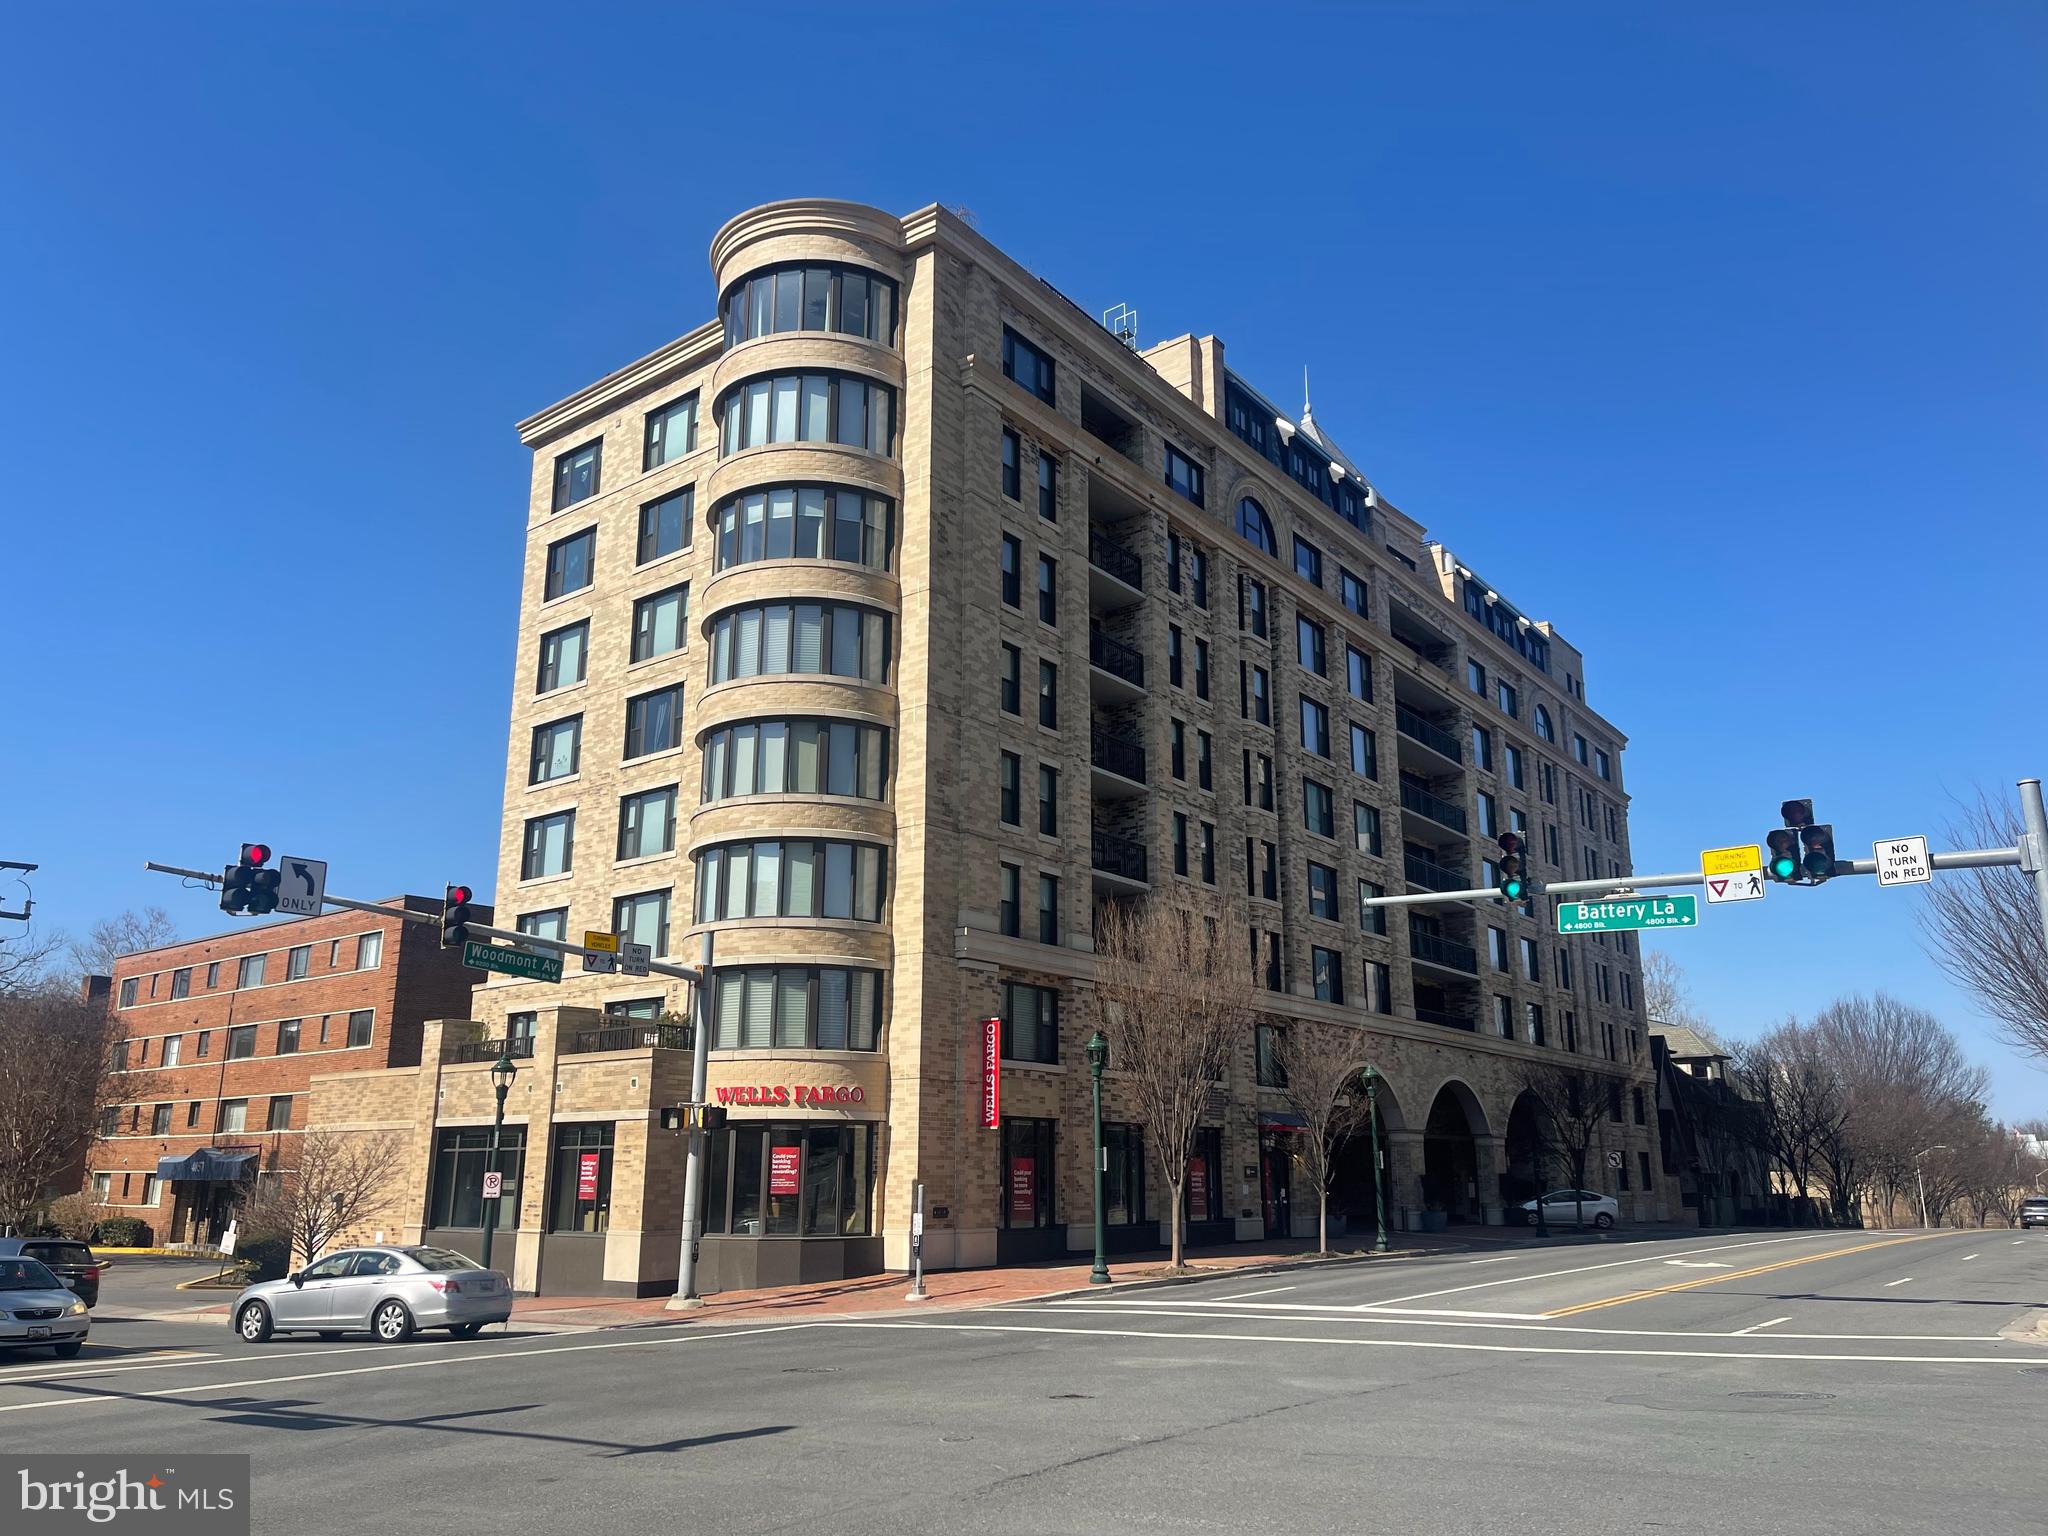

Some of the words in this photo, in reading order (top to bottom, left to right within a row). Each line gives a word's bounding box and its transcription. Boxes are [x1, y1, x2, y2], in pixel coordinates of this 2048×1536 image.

[1891, 844, 1909, 854] NO
[1715, 851, 1747, 861] TURNING
[1887, 855, 1917, 867] TURN
[1714, 860, 1749, 870] VEHICLES
[1883, 870, 1898, 880] ON
[1903, 867, 1925, 878] RED
[281, 897, 316, 911] ONLY
[1577, 903, 1646, 920] Battery
[1653, 900, 1675, 915] La
[1645, 917, 1665, 925] 4800
[471, 943, 538, 969] Woodmont
[541, 959, 558, 973] Av
[986, 1023, 996, 1071] FARGO
[715, 1086, 787, 1103] WELLS
[794, 1086, 865, 1104] FARGO
[985, 1073, 995, 1122] WELLS
